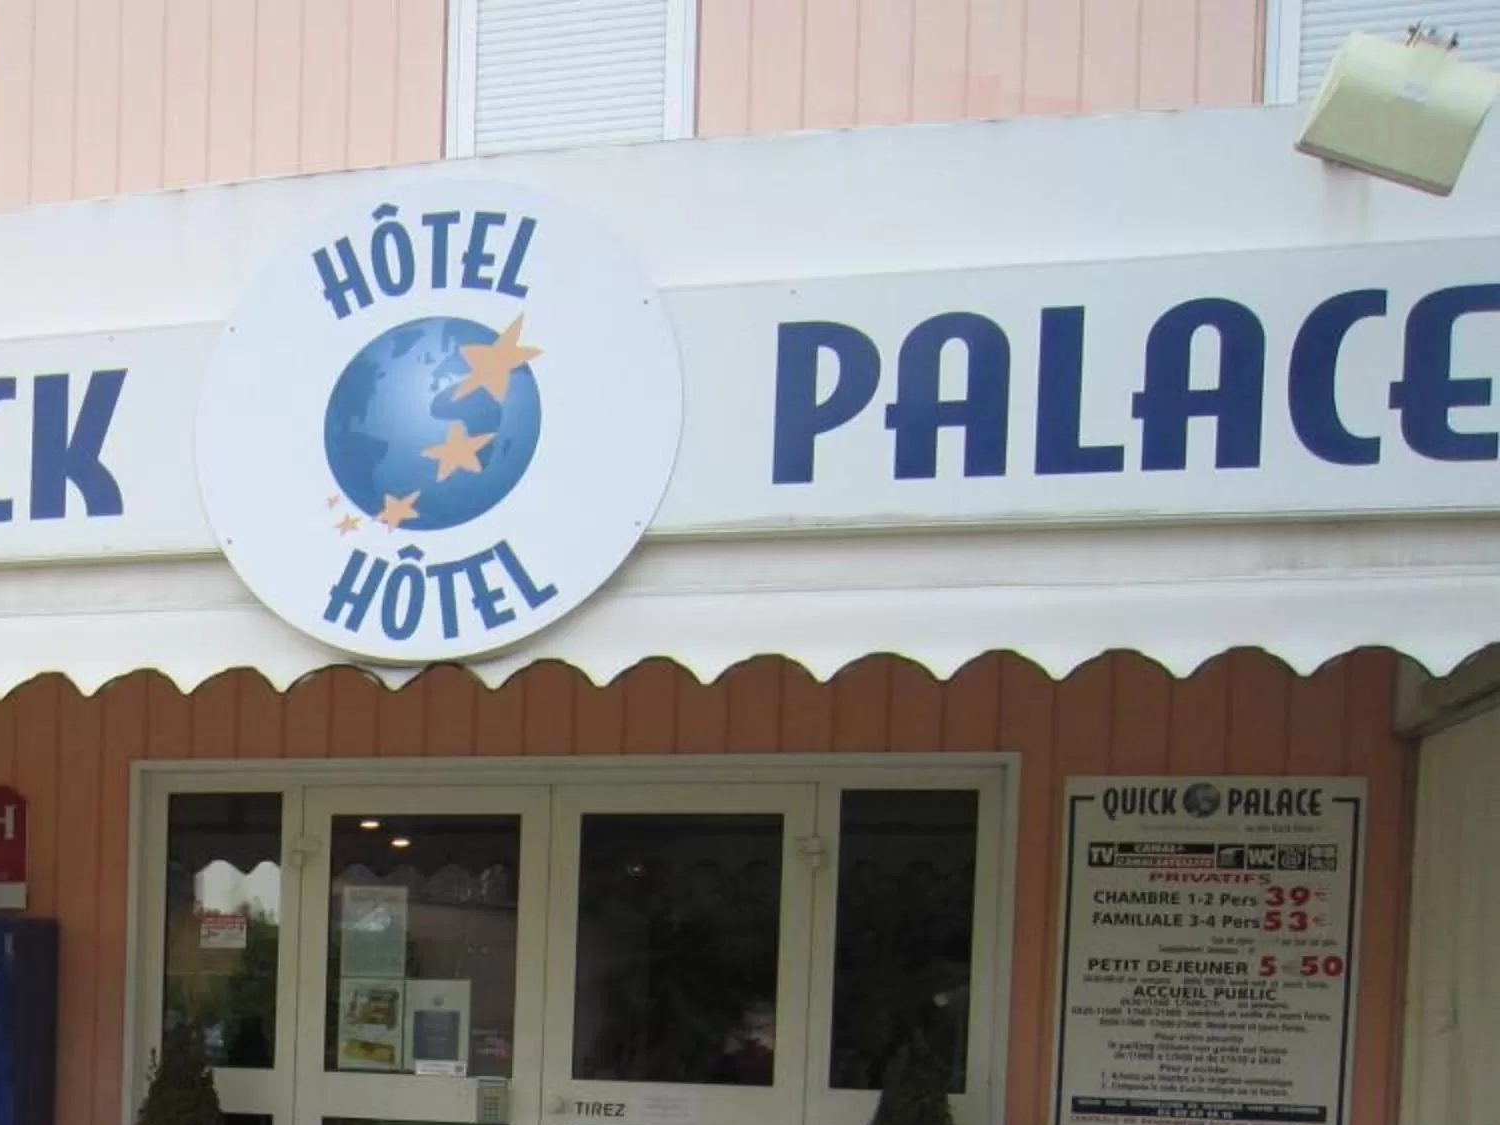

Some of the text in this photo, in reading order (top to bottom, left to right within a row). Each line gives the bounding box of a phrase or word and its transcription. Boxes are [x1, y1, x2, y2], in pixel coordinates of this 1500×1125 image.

[312, 202, 537, 319] HÔTEL
[772, 282, 1500, 485] PALACE
[322, 538, 558, 641] HÔTEL
[1102, 787, 1323, 820] QUICK PALACE
[1090, 847, 1276, 866] TV WC
[1149, 872, 1272, 885] PRIVATIFS
[1093, 890, 1180, 905] CHAMBRE
[1187, 891, 1214, 906] 1-2
[1219, 893, 1259, 908] Pers
[1092, 911, 1182, 927] FAMILIALE
[1190, 913, 1216, 929] 3-4
[1221, 914, 1260, 930] Pers
[1087, 958, 1141, 973] PETIT
[1146, 959, 1249, 975] DEJEUNER
[1133, 985, 1277, 1001] ACCUEIL PUBLIC
[574, 1101, 627, 1118] TIREZ
